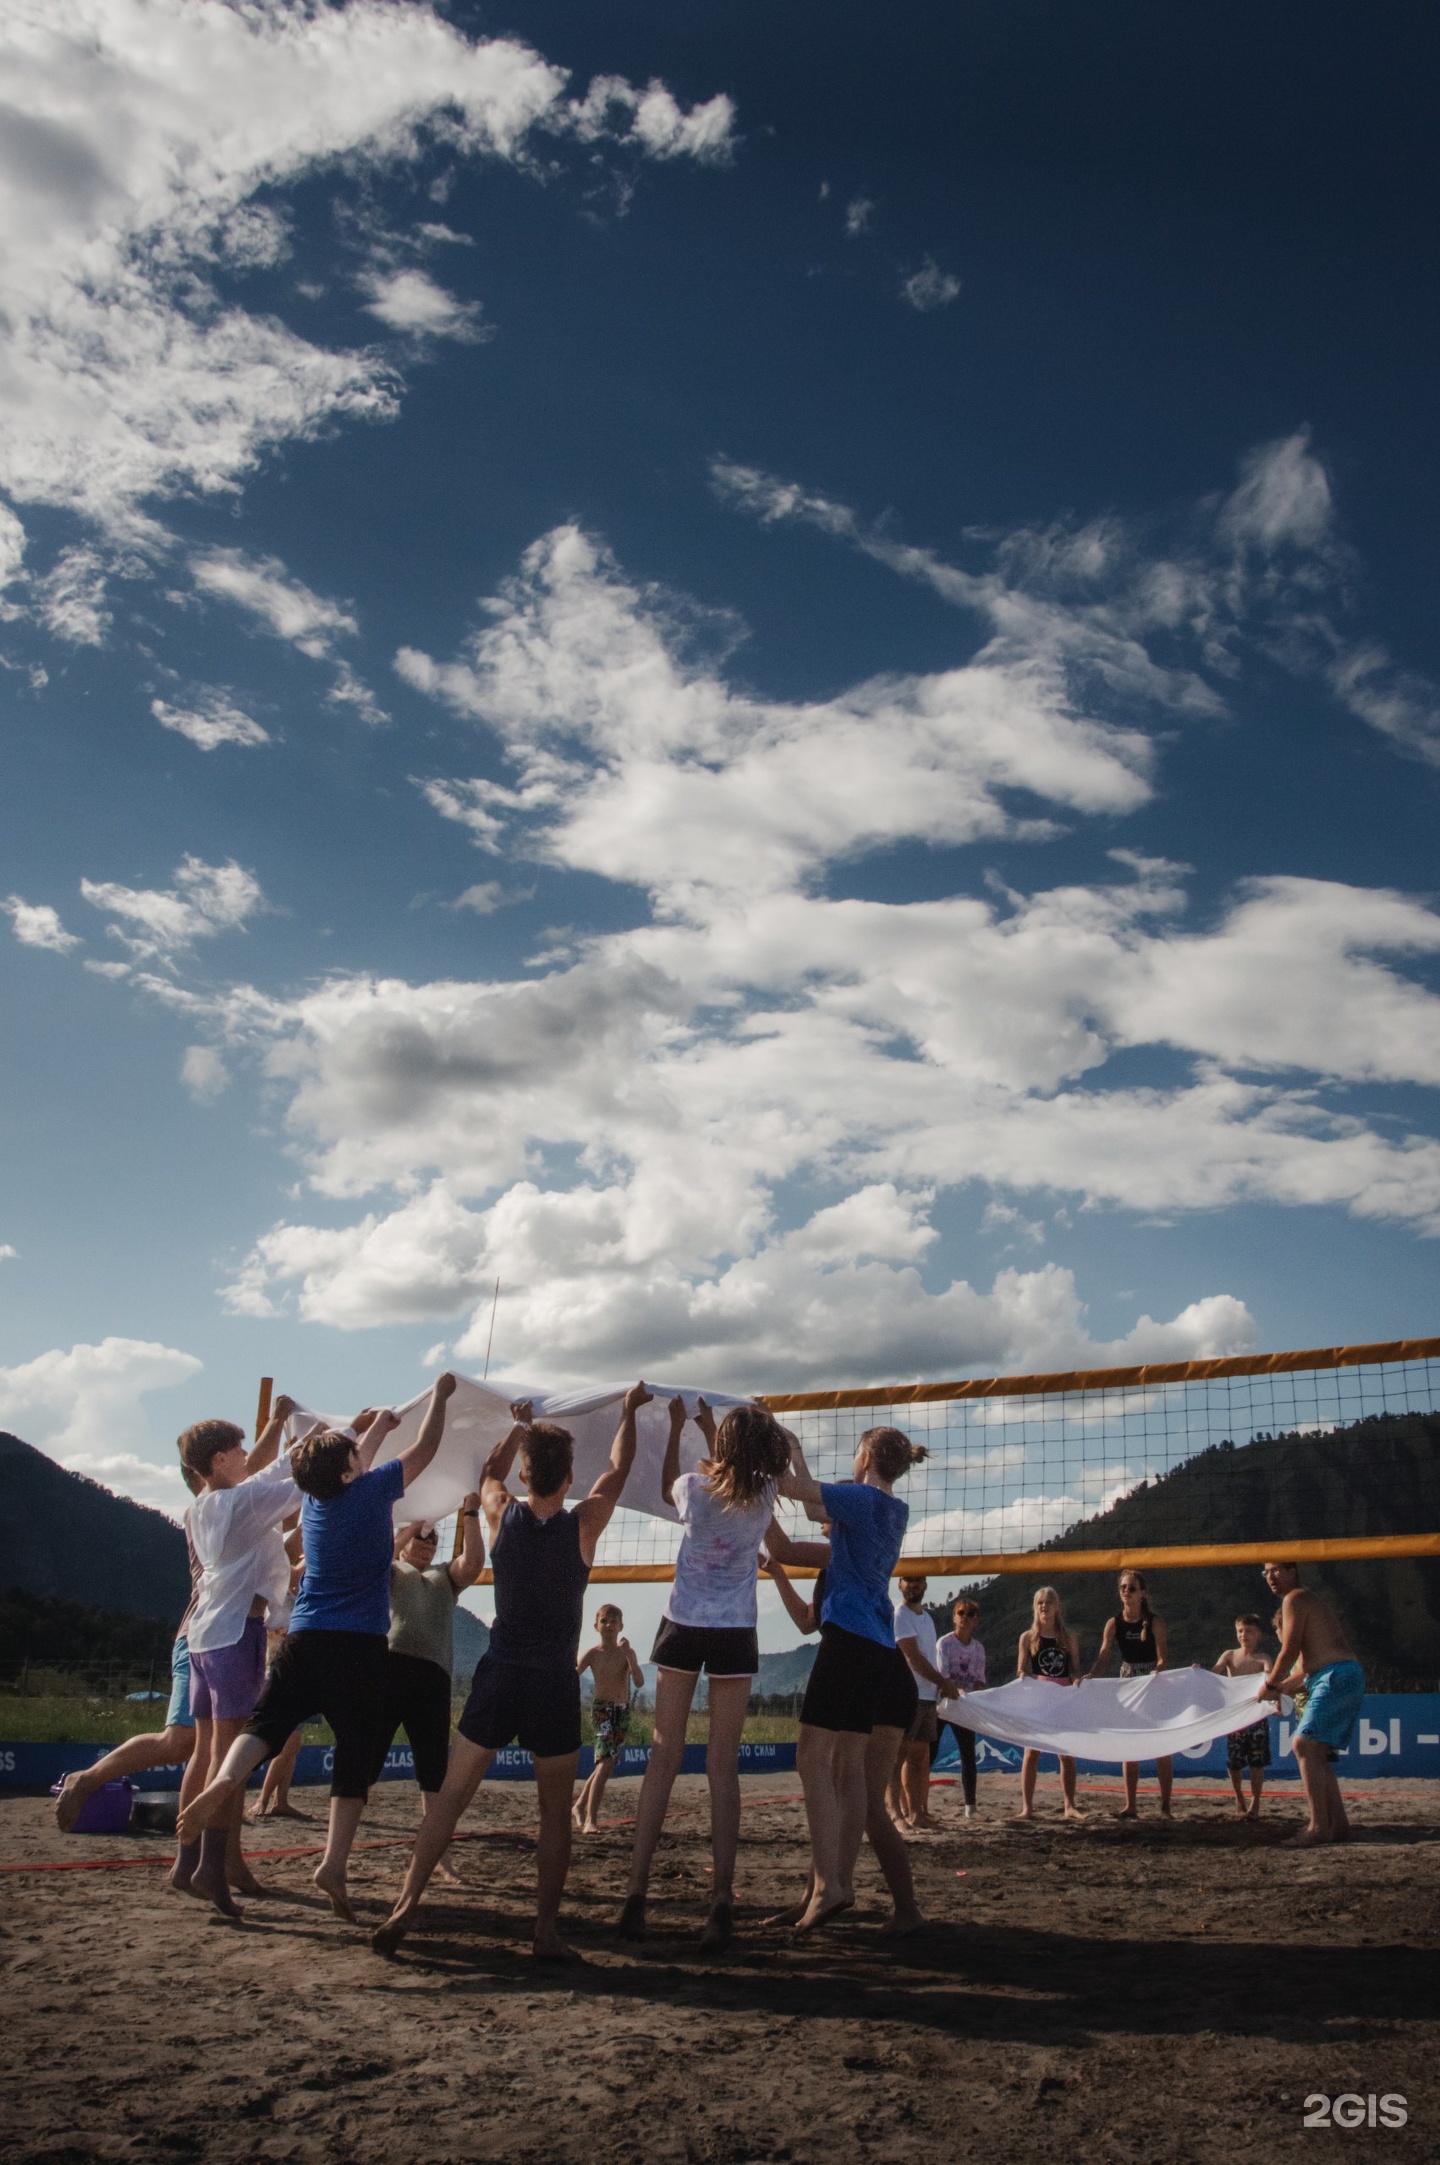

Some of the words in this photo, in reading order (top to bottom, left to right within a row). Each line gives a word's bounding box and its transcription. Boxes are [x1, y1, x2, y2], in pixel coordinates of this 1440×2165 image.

[624, 1749, 646, 1762] ALFA
[754, 1744, 776, 1757] СИЛЫ
[384, 1751, 414, 1768] CLAS
